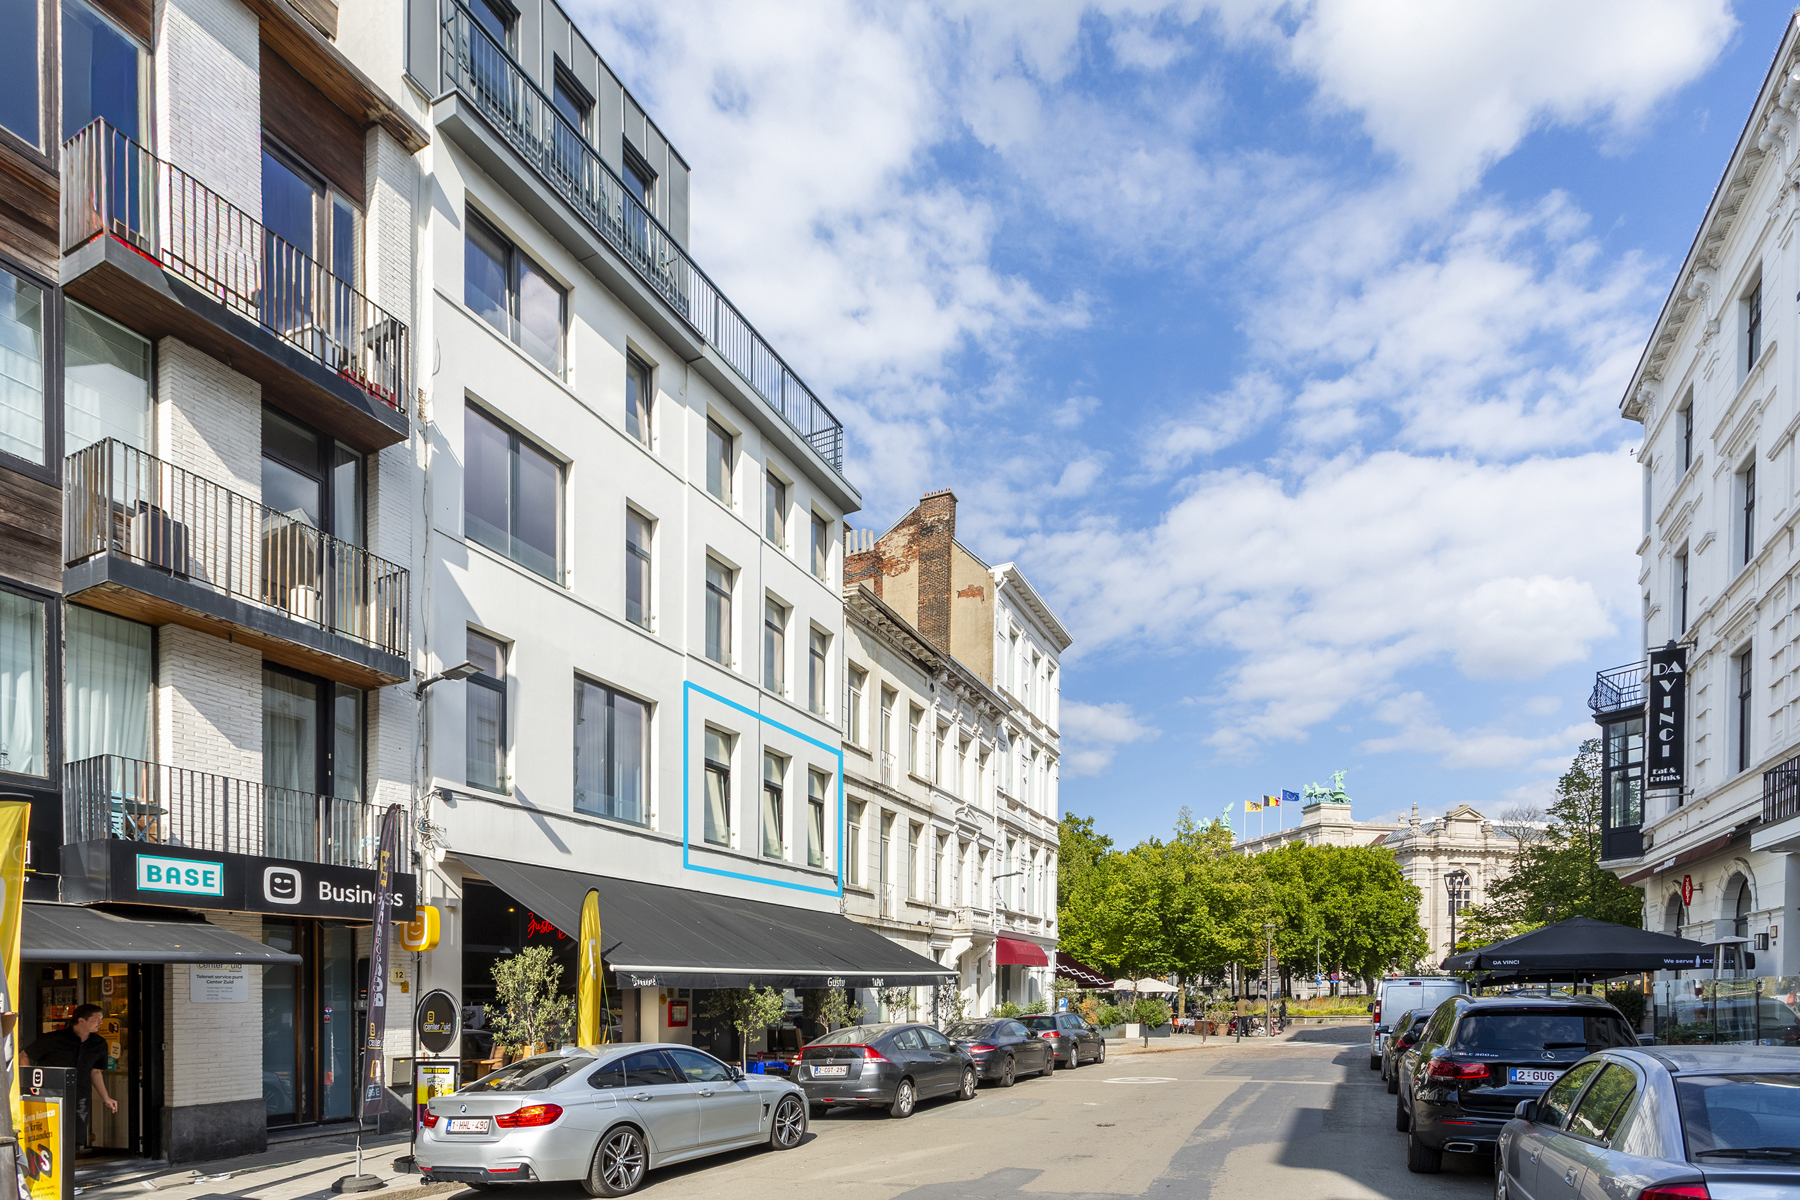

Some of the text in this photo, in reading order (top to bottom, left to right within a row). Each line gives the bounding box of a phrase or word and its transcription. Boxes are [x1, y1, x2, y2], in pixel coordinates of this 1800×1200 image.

[1652, 660, 1684, 677] DA
[1658, 678, 1677, 758] VINCI
[1649, 774, 1681, 783] Drinks
[146, 864, 216, 889] BASE
[395, 971, 404, 979] 12
[1518, 1071, 1561, 1081] 2-GUG-
[452, 1120, 488, 1130] 1-HHL-490
